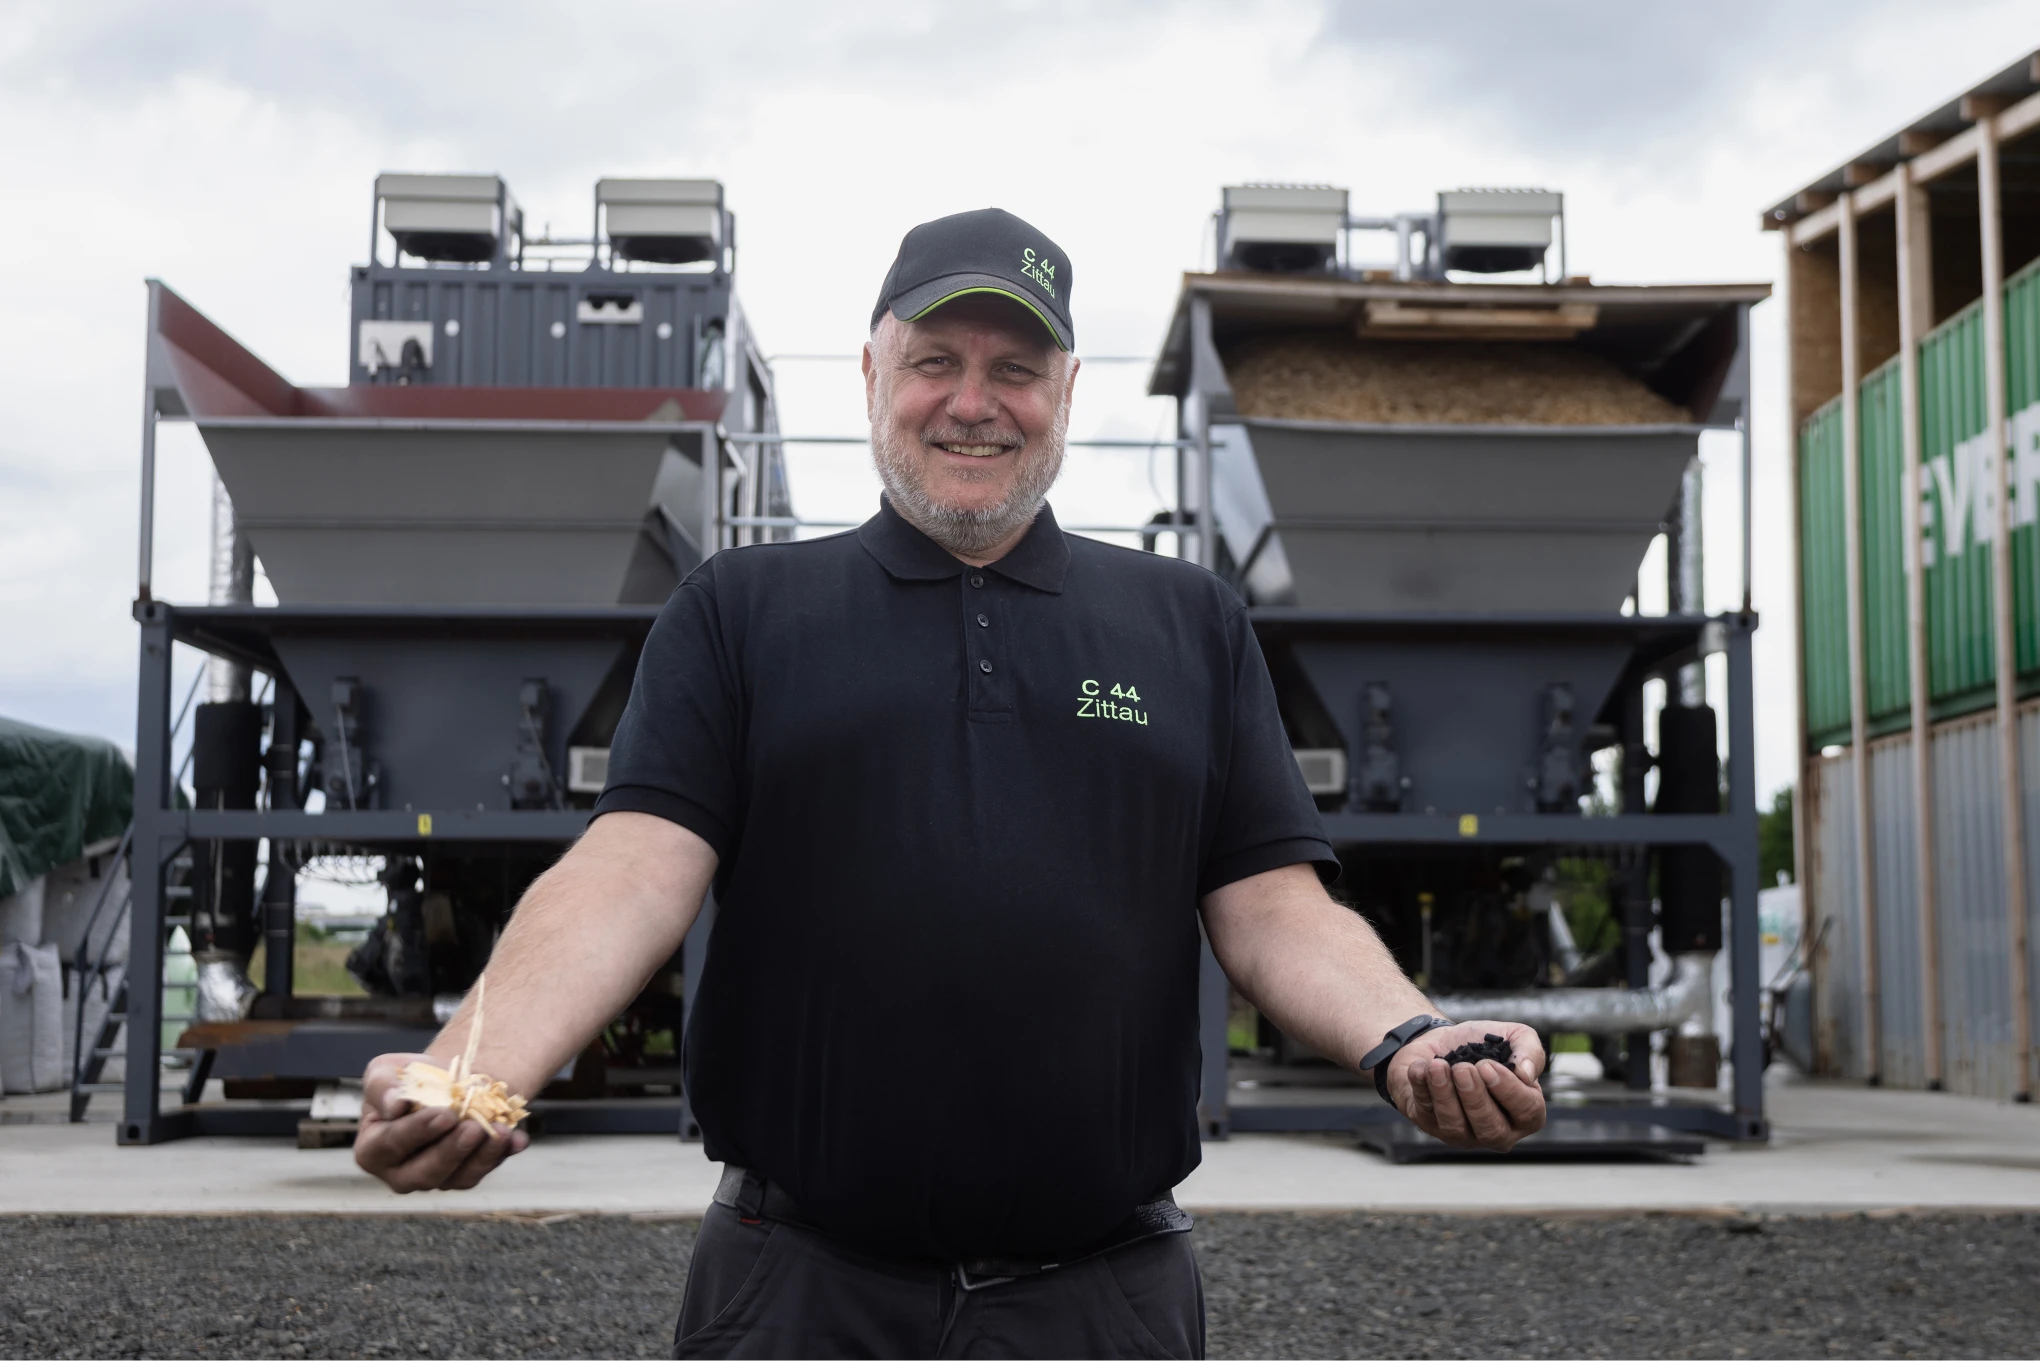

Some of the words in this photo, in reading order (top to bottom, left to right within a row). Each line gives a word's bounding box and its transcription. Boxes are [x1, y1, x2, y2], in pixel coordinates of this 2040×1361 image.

[1021, 259, 1055, 299] Zittau
[1024, 248, 1036, 262] C
[1040, 259, 1055, 280] 44
[1082, 680, 1099, 696] C
[1110, 683, 1141, 703] 44
[1076, 697, 1148, 726] Zittau
